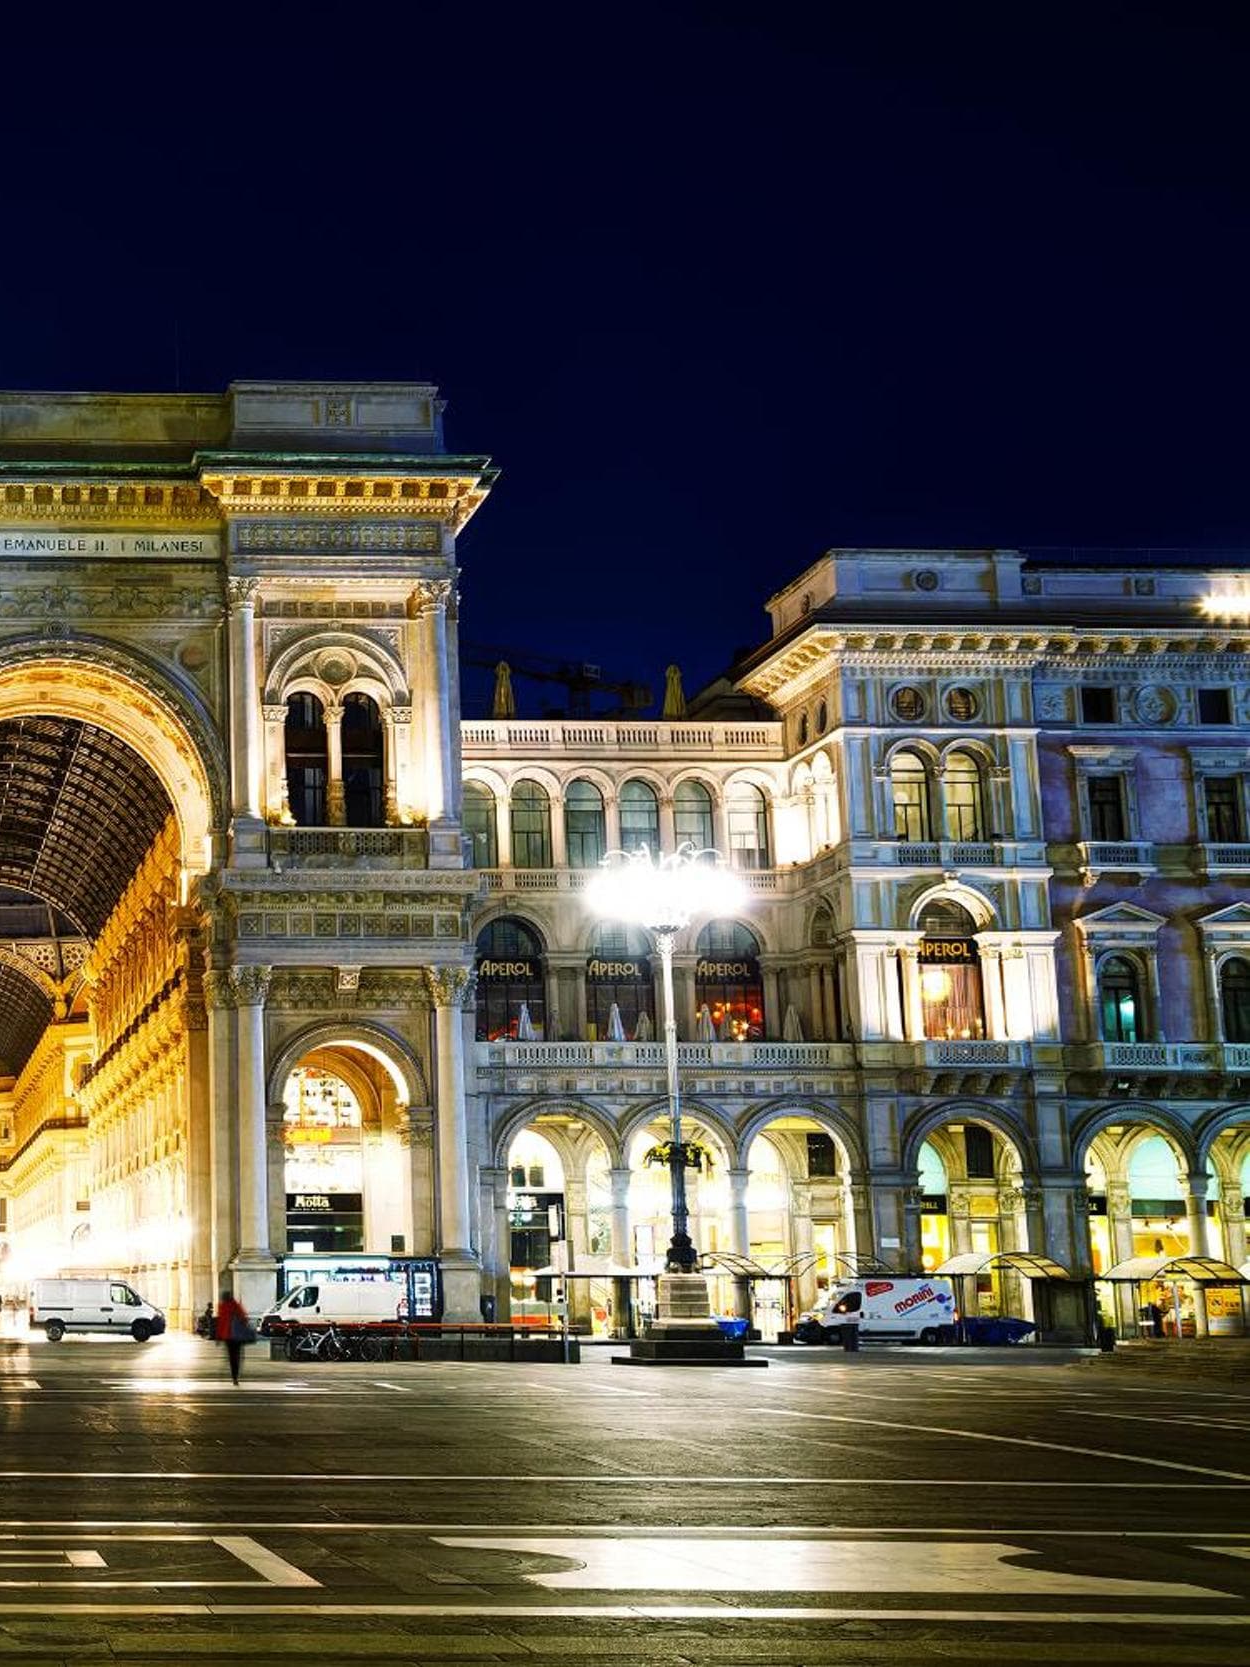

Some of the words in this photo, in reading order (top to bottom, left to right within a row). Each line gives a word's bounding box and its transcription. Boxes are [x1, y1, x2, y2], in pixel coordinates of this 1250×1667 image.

[4, 539, 86, 551] EMANUELE
[134, 540, 203, 552] MILANESI
[480, 960, 534, 976] APEROL
[589, 960, 642, 976] APEROL
[697, 961, 751, 976] APEROL
